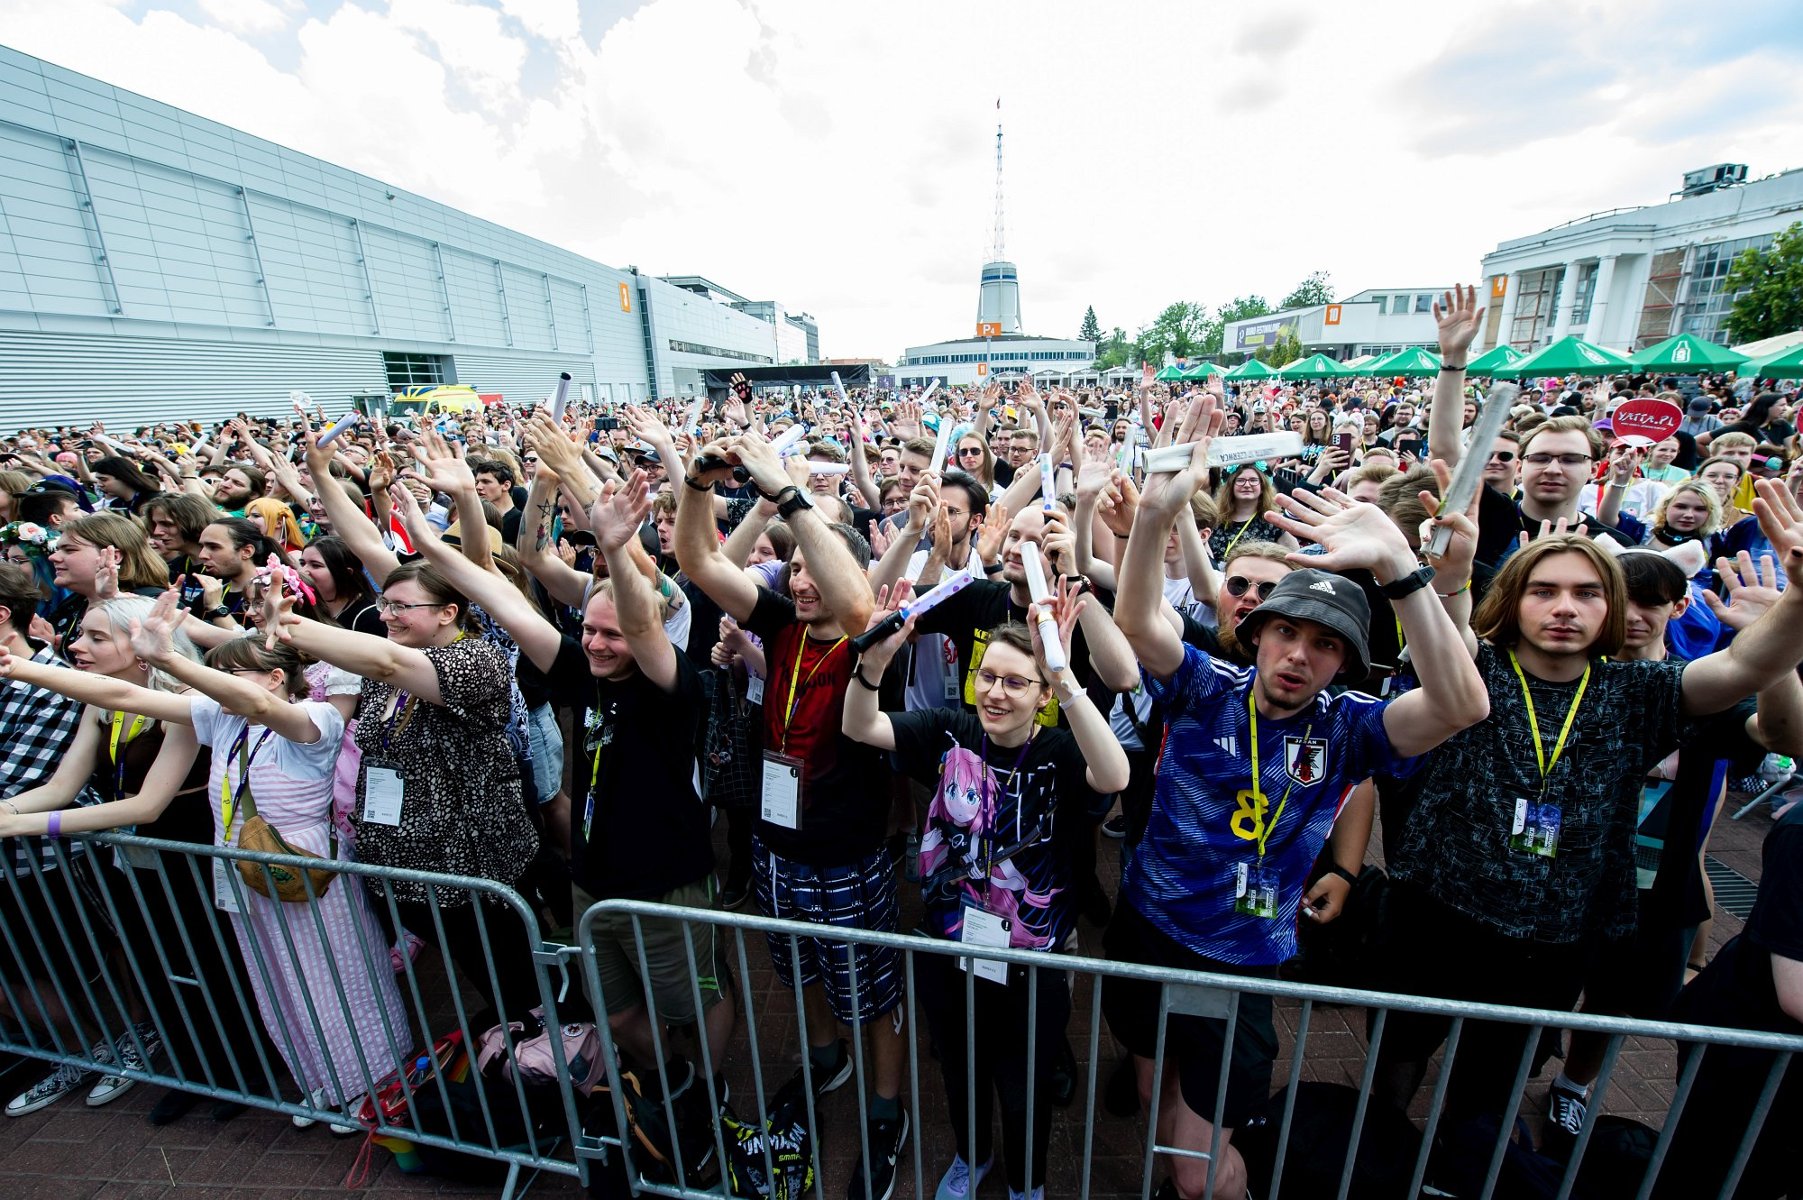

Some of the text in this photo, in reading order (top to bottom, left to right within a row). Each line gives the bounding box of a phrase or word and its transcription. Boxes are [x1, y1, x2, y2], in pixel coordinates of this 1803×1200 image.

[1329, 307, 1339, 322] 10
[983, 324, 995, 334] P4
[1618, 411, 1674, 427] YATTA.PL
[1230, 789, 1269, 841] 8
